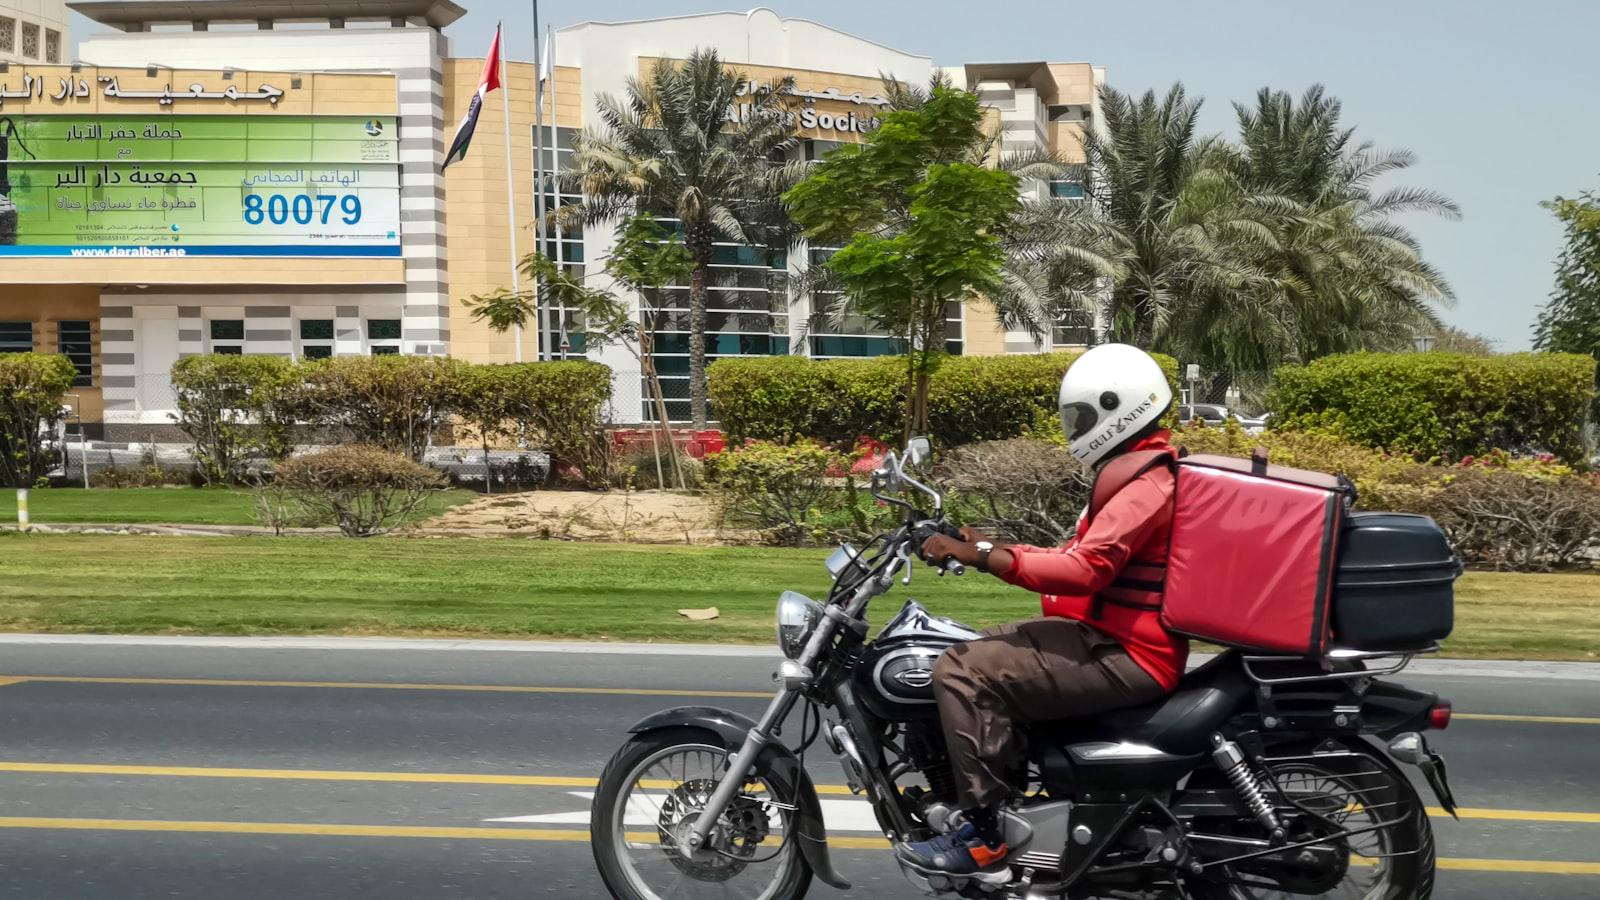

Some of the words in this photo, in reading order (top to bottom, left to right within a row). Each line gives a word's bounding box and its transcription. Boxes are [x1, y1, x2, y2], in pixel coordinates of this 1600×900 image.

[0, 72, 43, 103] الب
[49, 75, 90, 101] دار
[98, 75, 285, 106] جمعية
[108, 126, 137, 142] حفر
[143, 124, 182, 140] حملة
[54, 165, 86, 189] البر
[95, 165, 121, 188] دار
[129, 165, 198, 188] جمعية
[243, 194, 362, 225] 80079
[71, 246, 187, 257] www.daralber.ae
[1089, 428, 1114, 451] GULF
